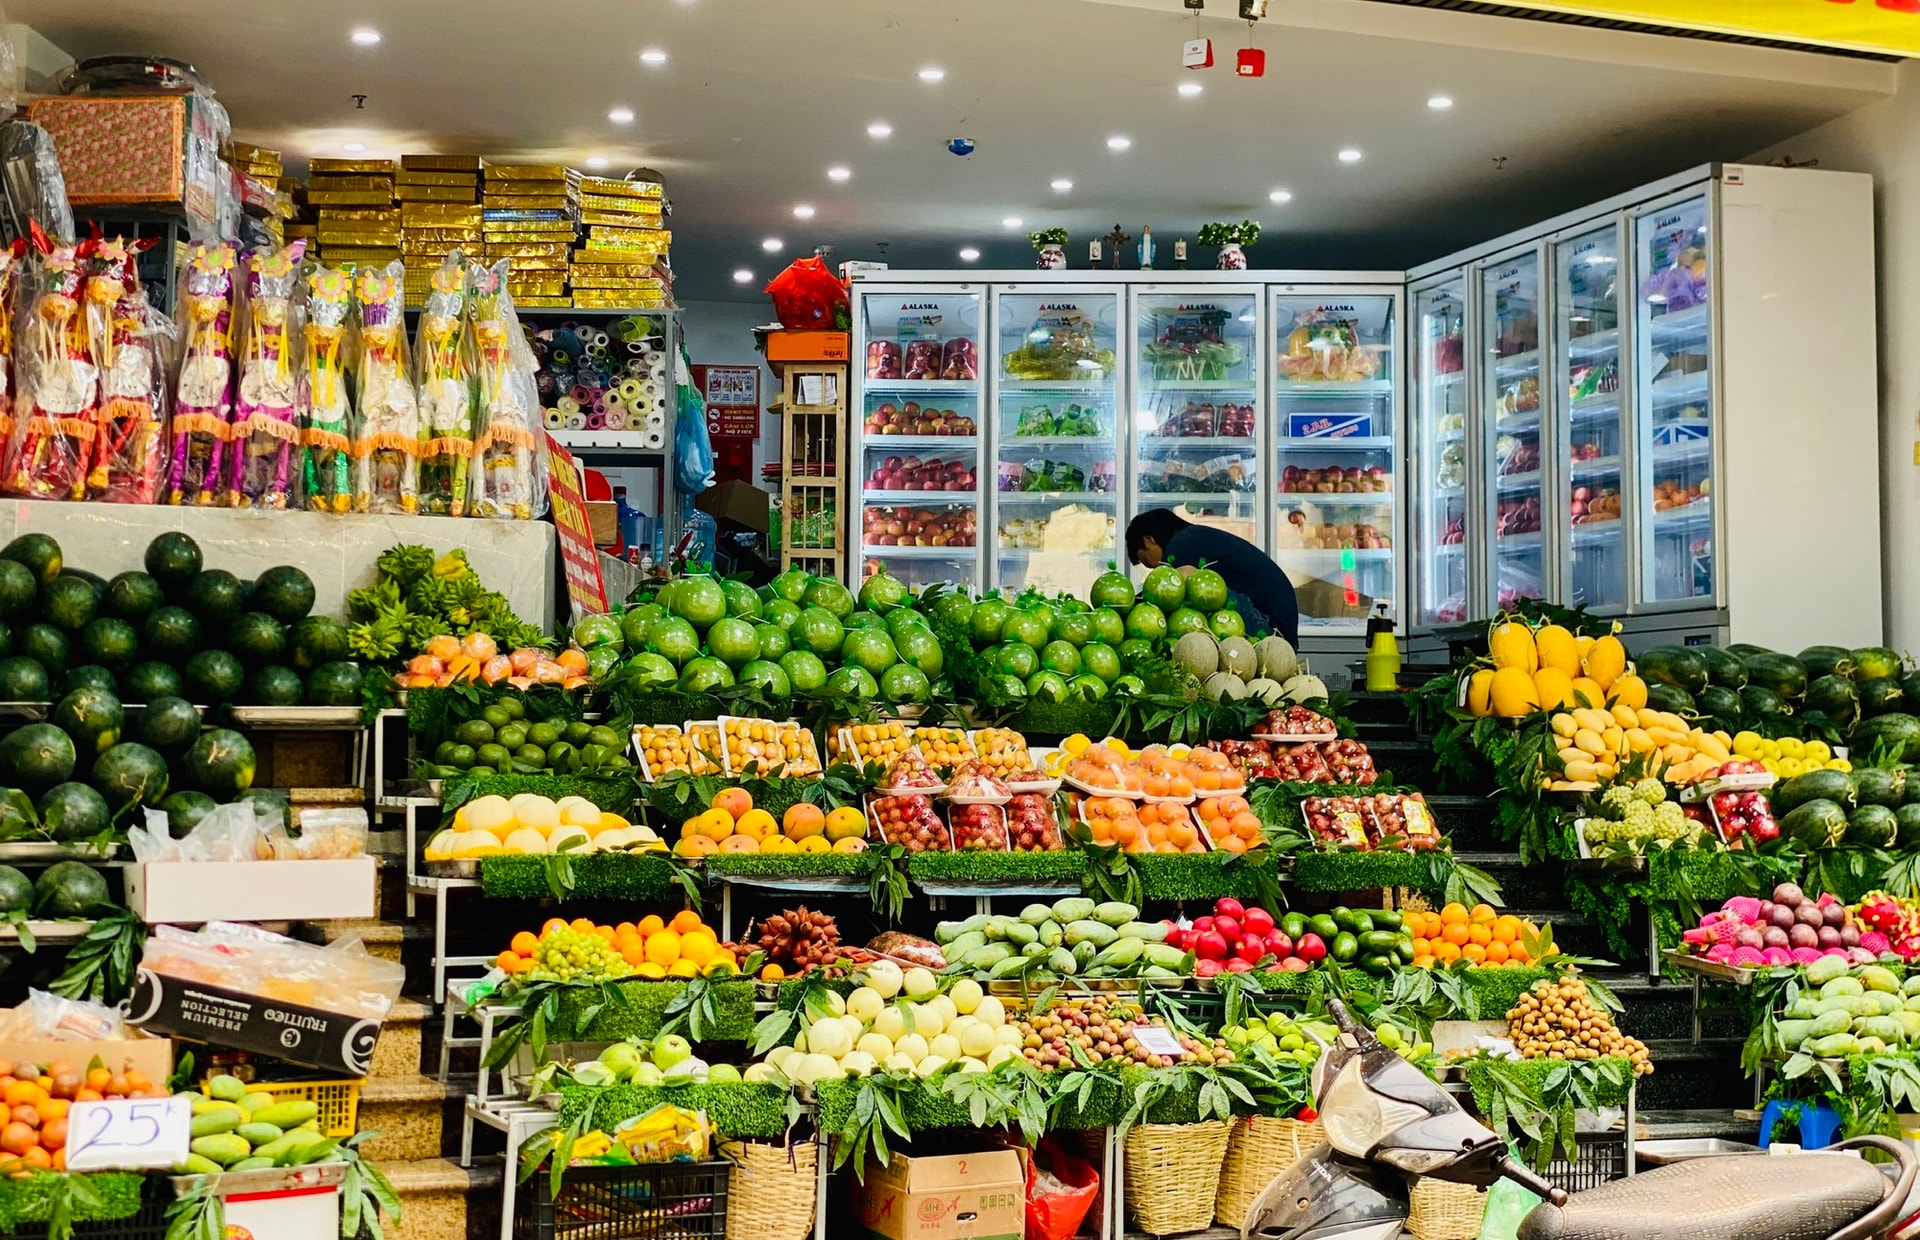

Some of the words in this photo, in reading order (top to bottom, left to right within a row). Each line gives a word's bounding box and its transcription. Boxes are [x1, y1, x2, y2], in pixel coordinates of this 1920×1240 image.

[180, 1000, 249, 1022] SELECTION
[182, 1011, 242, 1031] PREMIUM
[264, 1009, 328, 1032] FRUITICO
[958, 1160, 968, 1175] 2
[925, 1203, 938, 1212] MH
